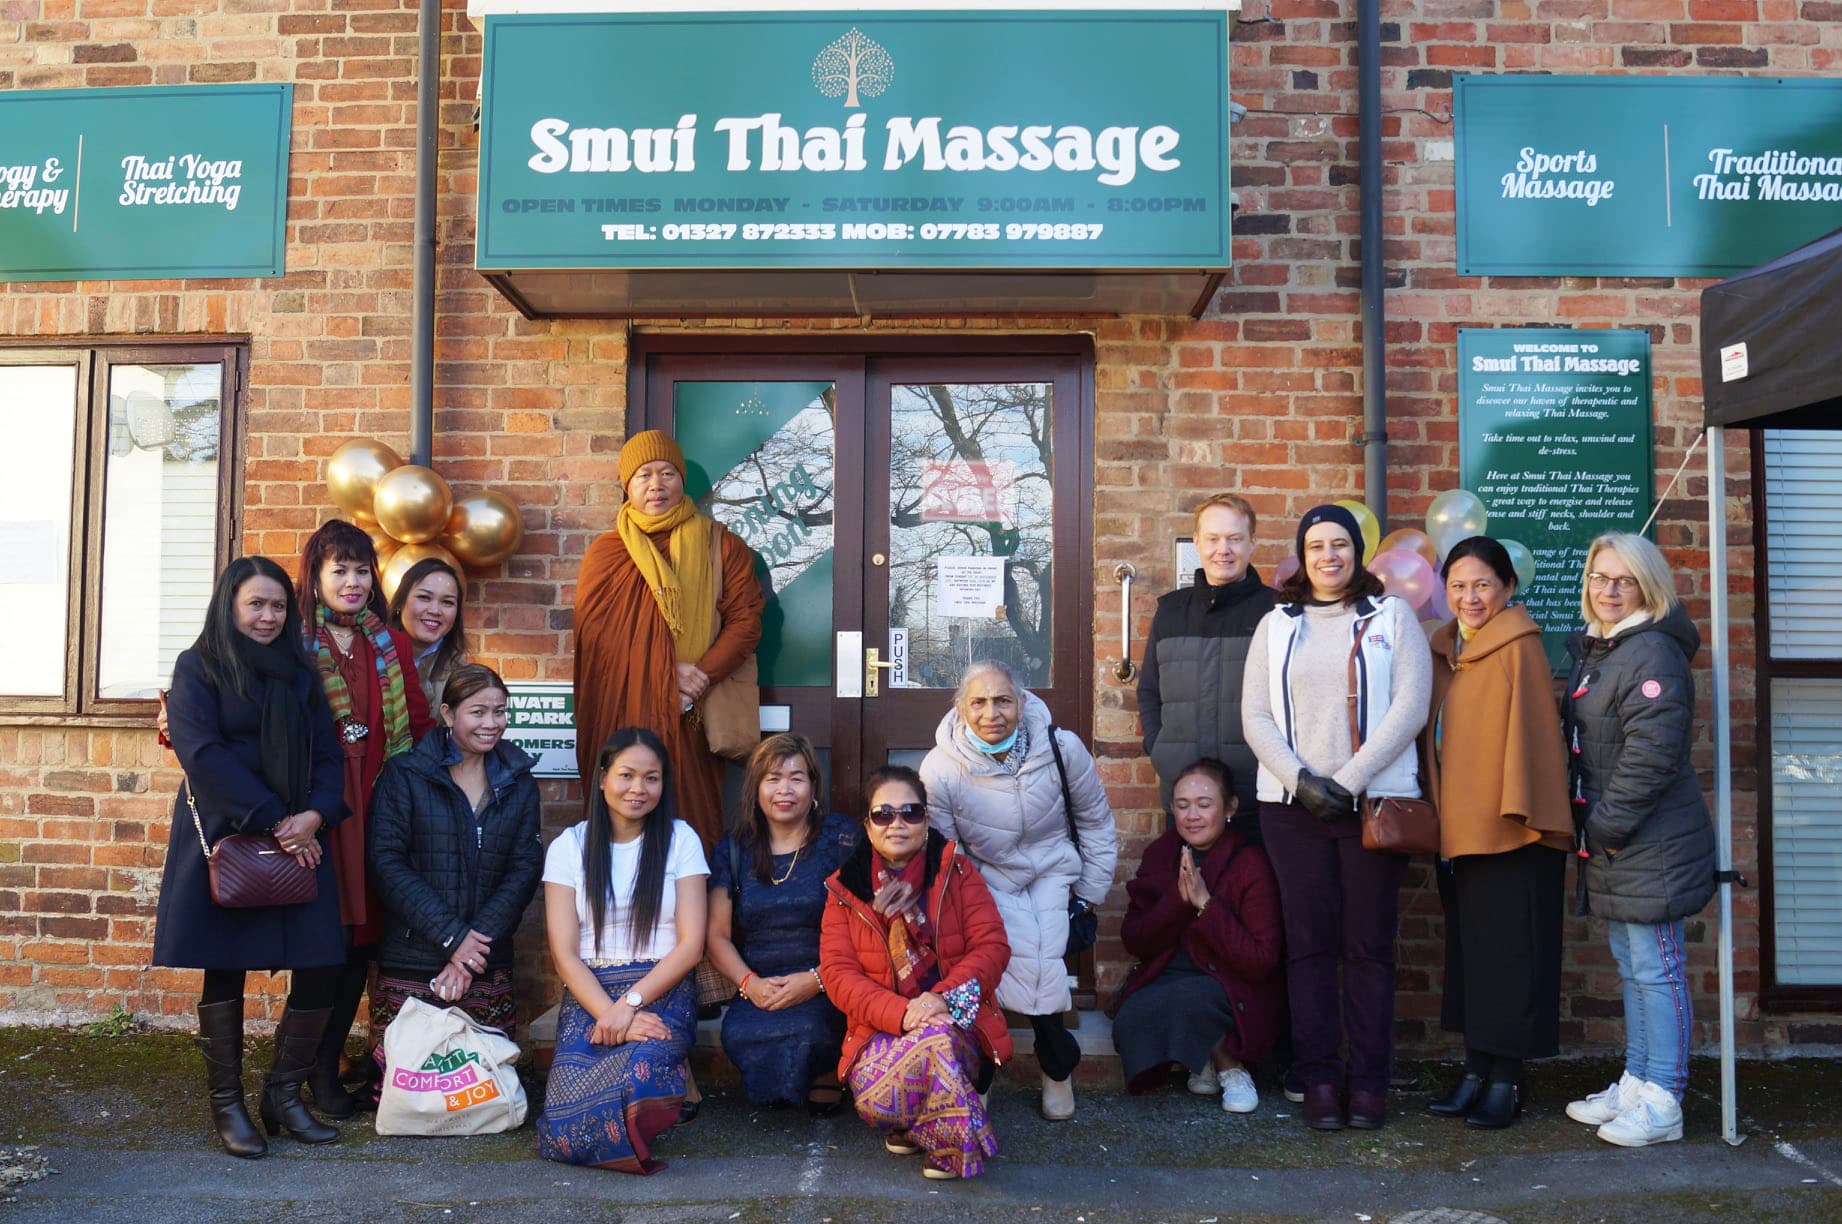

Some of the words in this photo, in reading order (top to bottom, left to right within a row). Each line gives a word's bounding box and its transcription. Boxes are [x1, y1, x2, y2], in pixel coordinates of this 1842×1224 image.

[528, 113, 698, 174] Smui
[714, 112, 868, 172] Thai
[883, 116, 1181, 186] Massage
[1516, 147, 1597, 180] Sports
[1708, 148, 1842, 175] Traditiona
[42, 157, 64, 182] &
[121, 155, 175, 180] Thai
[179, 153, 243, 186] Yoga
[1501, 172, 1615, 206] Massage
[1693, 174, 1751, 200] Thai
[1757, 174, 1842, 202] Massa
[0, 188, 69, 215] erapy
[119, 180, 242, 211] Stretching
[502, 198, 575, 213] OPEN
[580, 198, 661, 213] TIMES
[673, 197, 790, 212] MONDAY
[822, 197, 964, 212] SATURDAY
[978, 197, 1074, 212] 9:00AM
[1107, 197, 1206, 212] 8:00PM
[601, 223, 656, 240] TEL:
[742, 223, 836, 241] 872333
[841, 223, 914, 240] MOB:
[919, 223, 1000, 241] 07783
[1005, 223, 1104, 241] 979887
[1513, 344, 1578, 353] WELCOME
[1581, 344, 1598, 353] TO
[1472, 355, 1517, 372] Smui
[1521, 355, 1561, 372] Thai
[1564, 356, 1641, 377] Massage
[1482, 383, 1506, 393] Smui
[1509, 383, 1531, 392] Thai
[1534, 383, 1573, 395] Massage
[1575, 383, 1603, 393] invites
[1605, 386, 1620, 395] you
[1623, 384, 1632, 393] to
[1476, 396, 1510, 405] discover
[1530, 396, 1555, 405] haven
[1558, 396, 1569, 408] of
[1571, 396, 1618, 407] therapeutic
[1620, 396, 1637, 405] and
[1504, 409, 1540, 419] relaxing
[1543, 409, 1566, 418] Thai
[1568, 409, 1609, 420] Massage.
[1482, 433, 1504, 443] Take
[1506, 433, 1524, 443] time
[1527, 434, 1541, 443] out
[1543, 434, 1552, 443] to
[1554, 433, 1579, 444] relax,
[1582, 433, 1615, 443] unwind
[1617, 434, 1635, 443] and
[1538, 446, 1578, 456] de-stress.
[1486, 471, 1508, 481] Here
[1510, 472, 1520, 481] at
[1522, 471, 1546, 481] Smui
[1549, 471, 1572, 481] Thai
[1574, 471, 1614, 482] Massage
[1614, 475, 1631, 484] you
[1478, 485, 1494, 493] can
[1496, 483, 1519, 495] enjoy
[1521, 483, 1568, 493] traditional
[1570, 483, 1593, 493] Thai
[1595, 483, 1640, 495] Therapies
[732, 463, 817, 541] ening
[1491, 497, 1515, 508] great
[1516, 498, 1536, 508] way
[1538, 498, 1547, 506] to
[1549, 498, 1583, 508] energise
[1585, 497, 1602, 506] and
[1604, 497, 1633, 506] release
[1508, 508, 1526, 518] and
[1528, 508, 1546, 520] stiff
[1550, 509, 1575, 520] necks,
[1578, 509, 1614, 518] shoulder
[1617, 509, 1634, 518] and
[1548, 521, 1570, 531] back.
[760, 516, 813, 570] oon
[1533, 549, 1557, 558] range
[1558, 547, 1570, 558] of
[1535, 560, 1565, 568] itional
[1568, 560, 1586, 568] Th
[1561, 573, 1578, 581] and
[1533, 585, 1557, 594] Thai
[1559, 585, 1576, 594] and
[1526, 598, 1543, 607] that
[1546, 598, 1562, 607] has
[1551, 611, 1574, 619] Smui
[1545, 624, 1572, 632] health
[894, 633, 904, 682] PUSH
[507, 696, 565, 709] IVATE
[515, 712, 574, 725] PARK
[512, 739, 576, 749] OMERS
[396, 1069, 473, 1090] COMFORT
[449, 1095, 460, 1107] &
[466, 1081, 495, 1106] JOY
